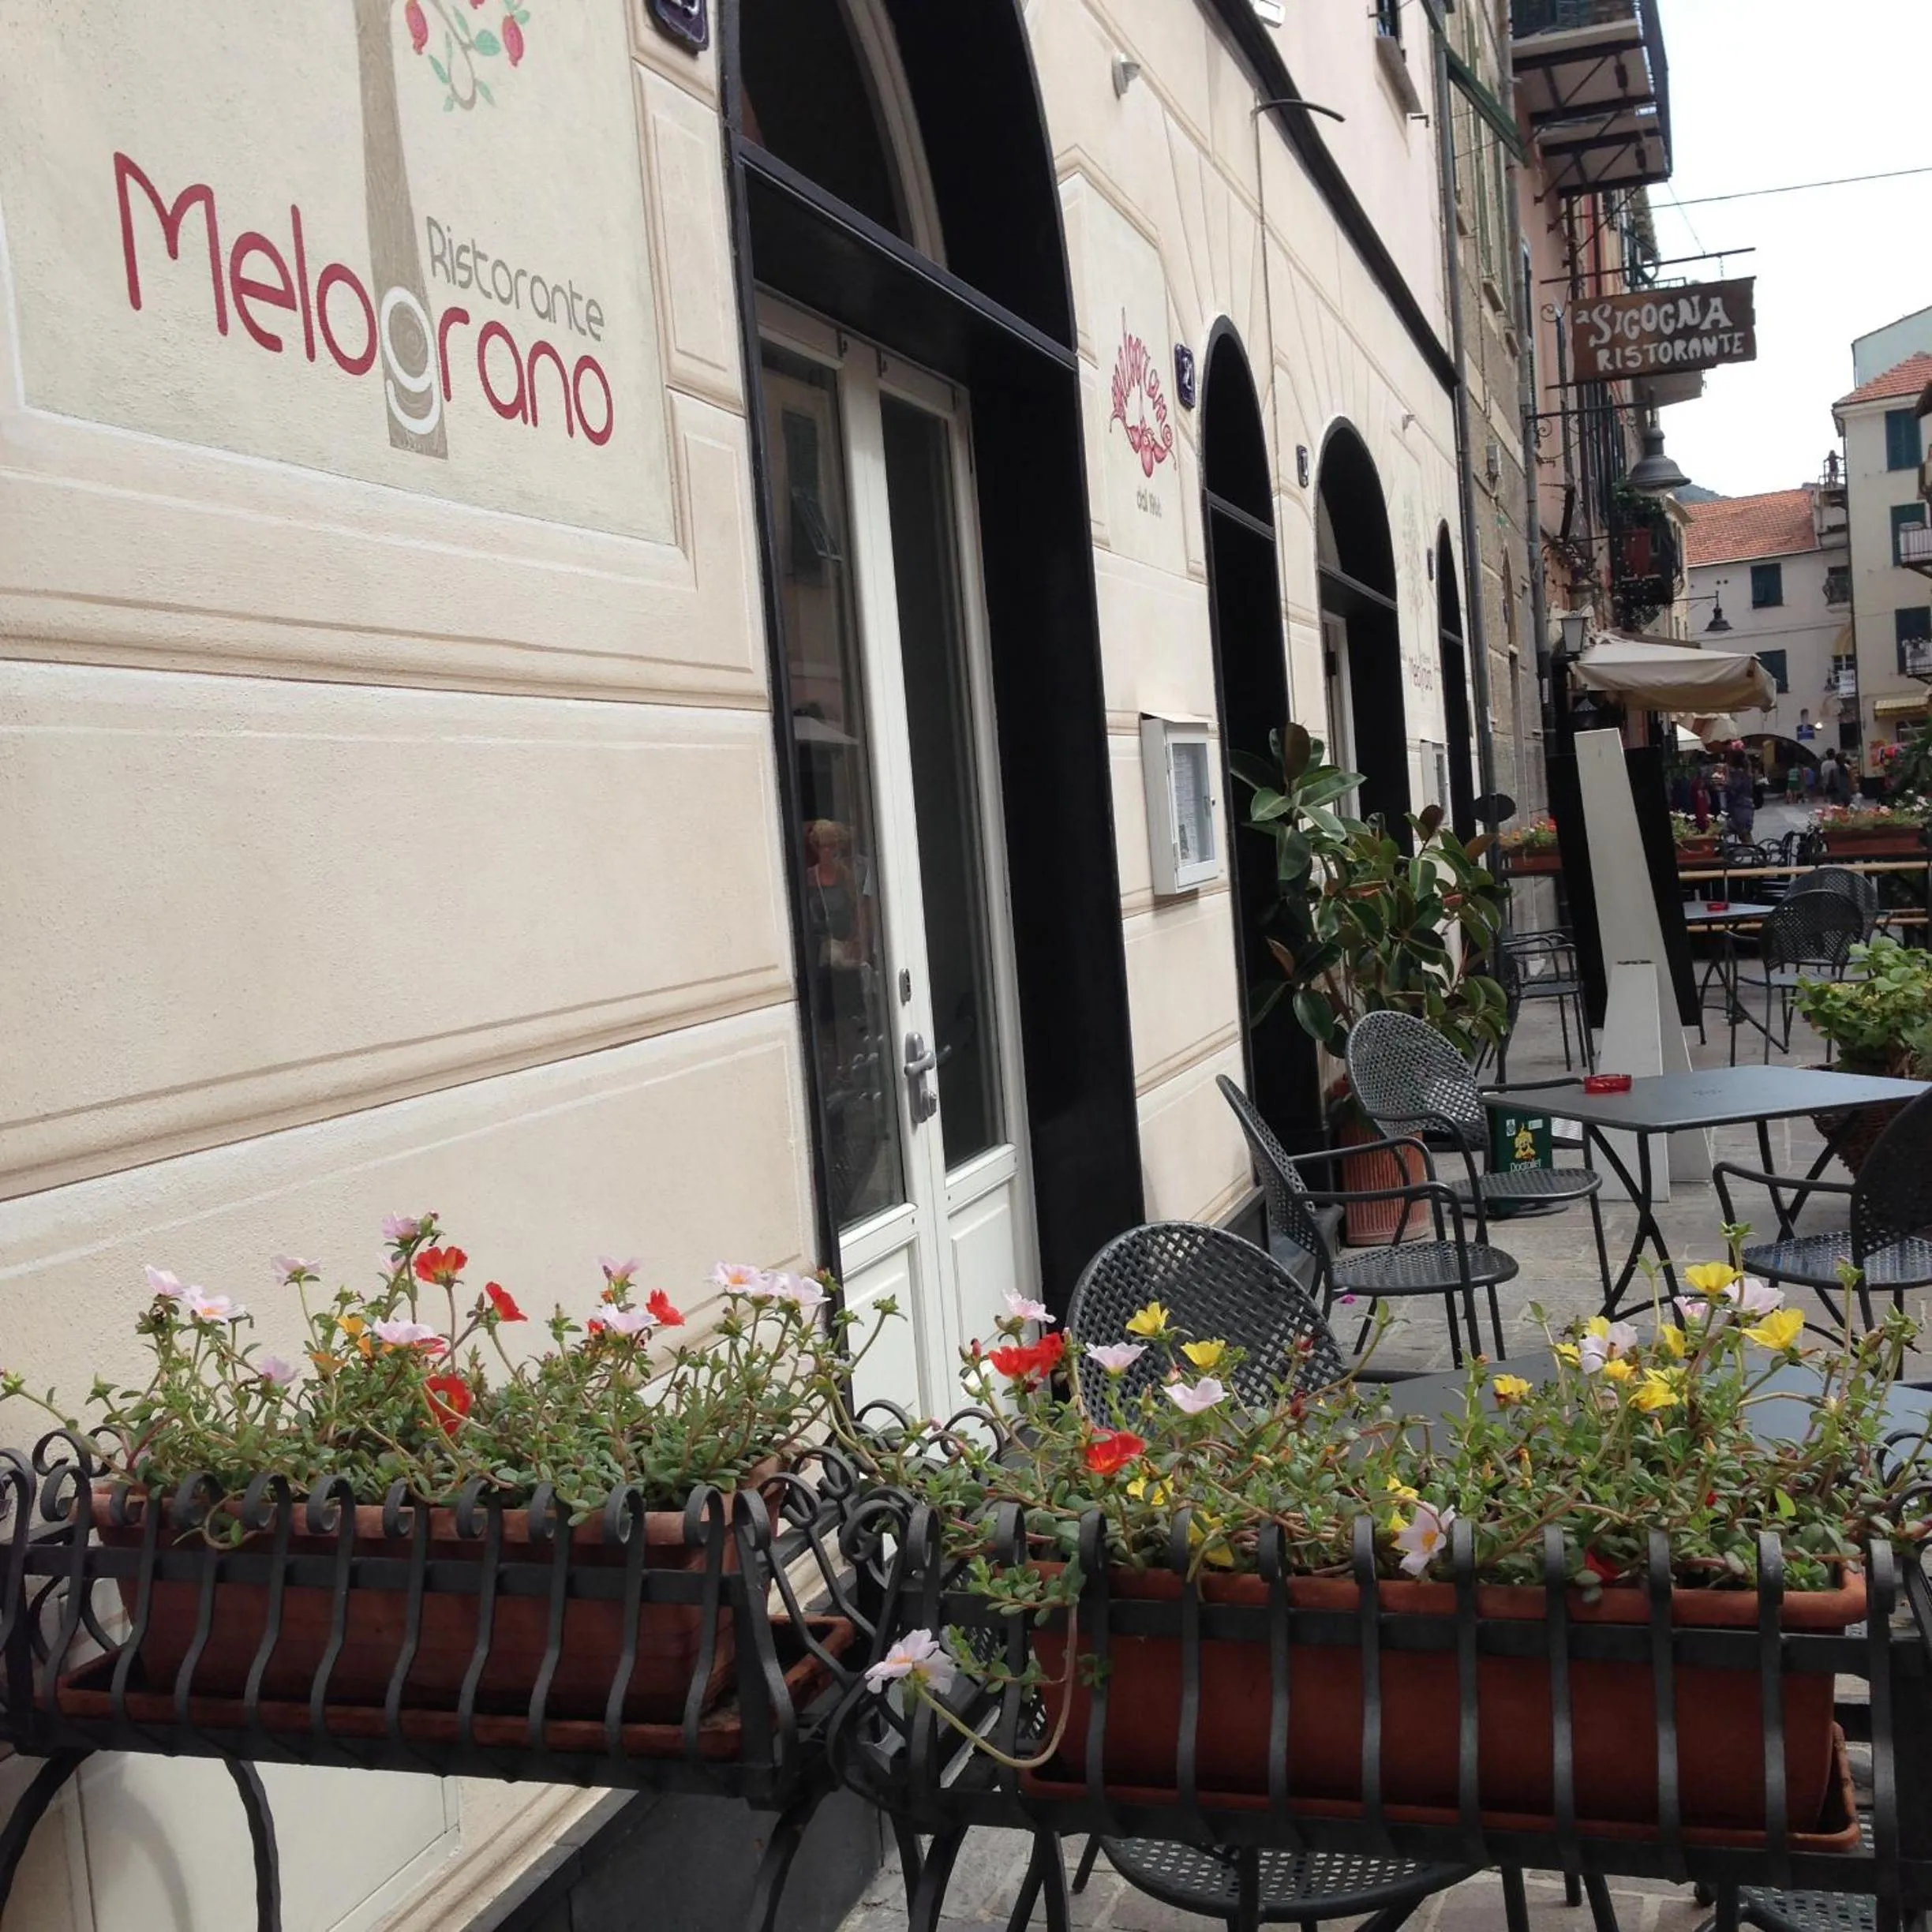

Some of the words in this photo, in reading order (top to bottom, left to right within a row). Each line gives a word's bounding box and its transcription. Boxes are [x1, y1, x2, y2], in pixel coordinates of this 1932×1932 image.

[113, 151, 614, 447] Melograno
[427, 215, 605, 342] Ristorante
[1597, 331, 1745, 372] RISTORANTE
